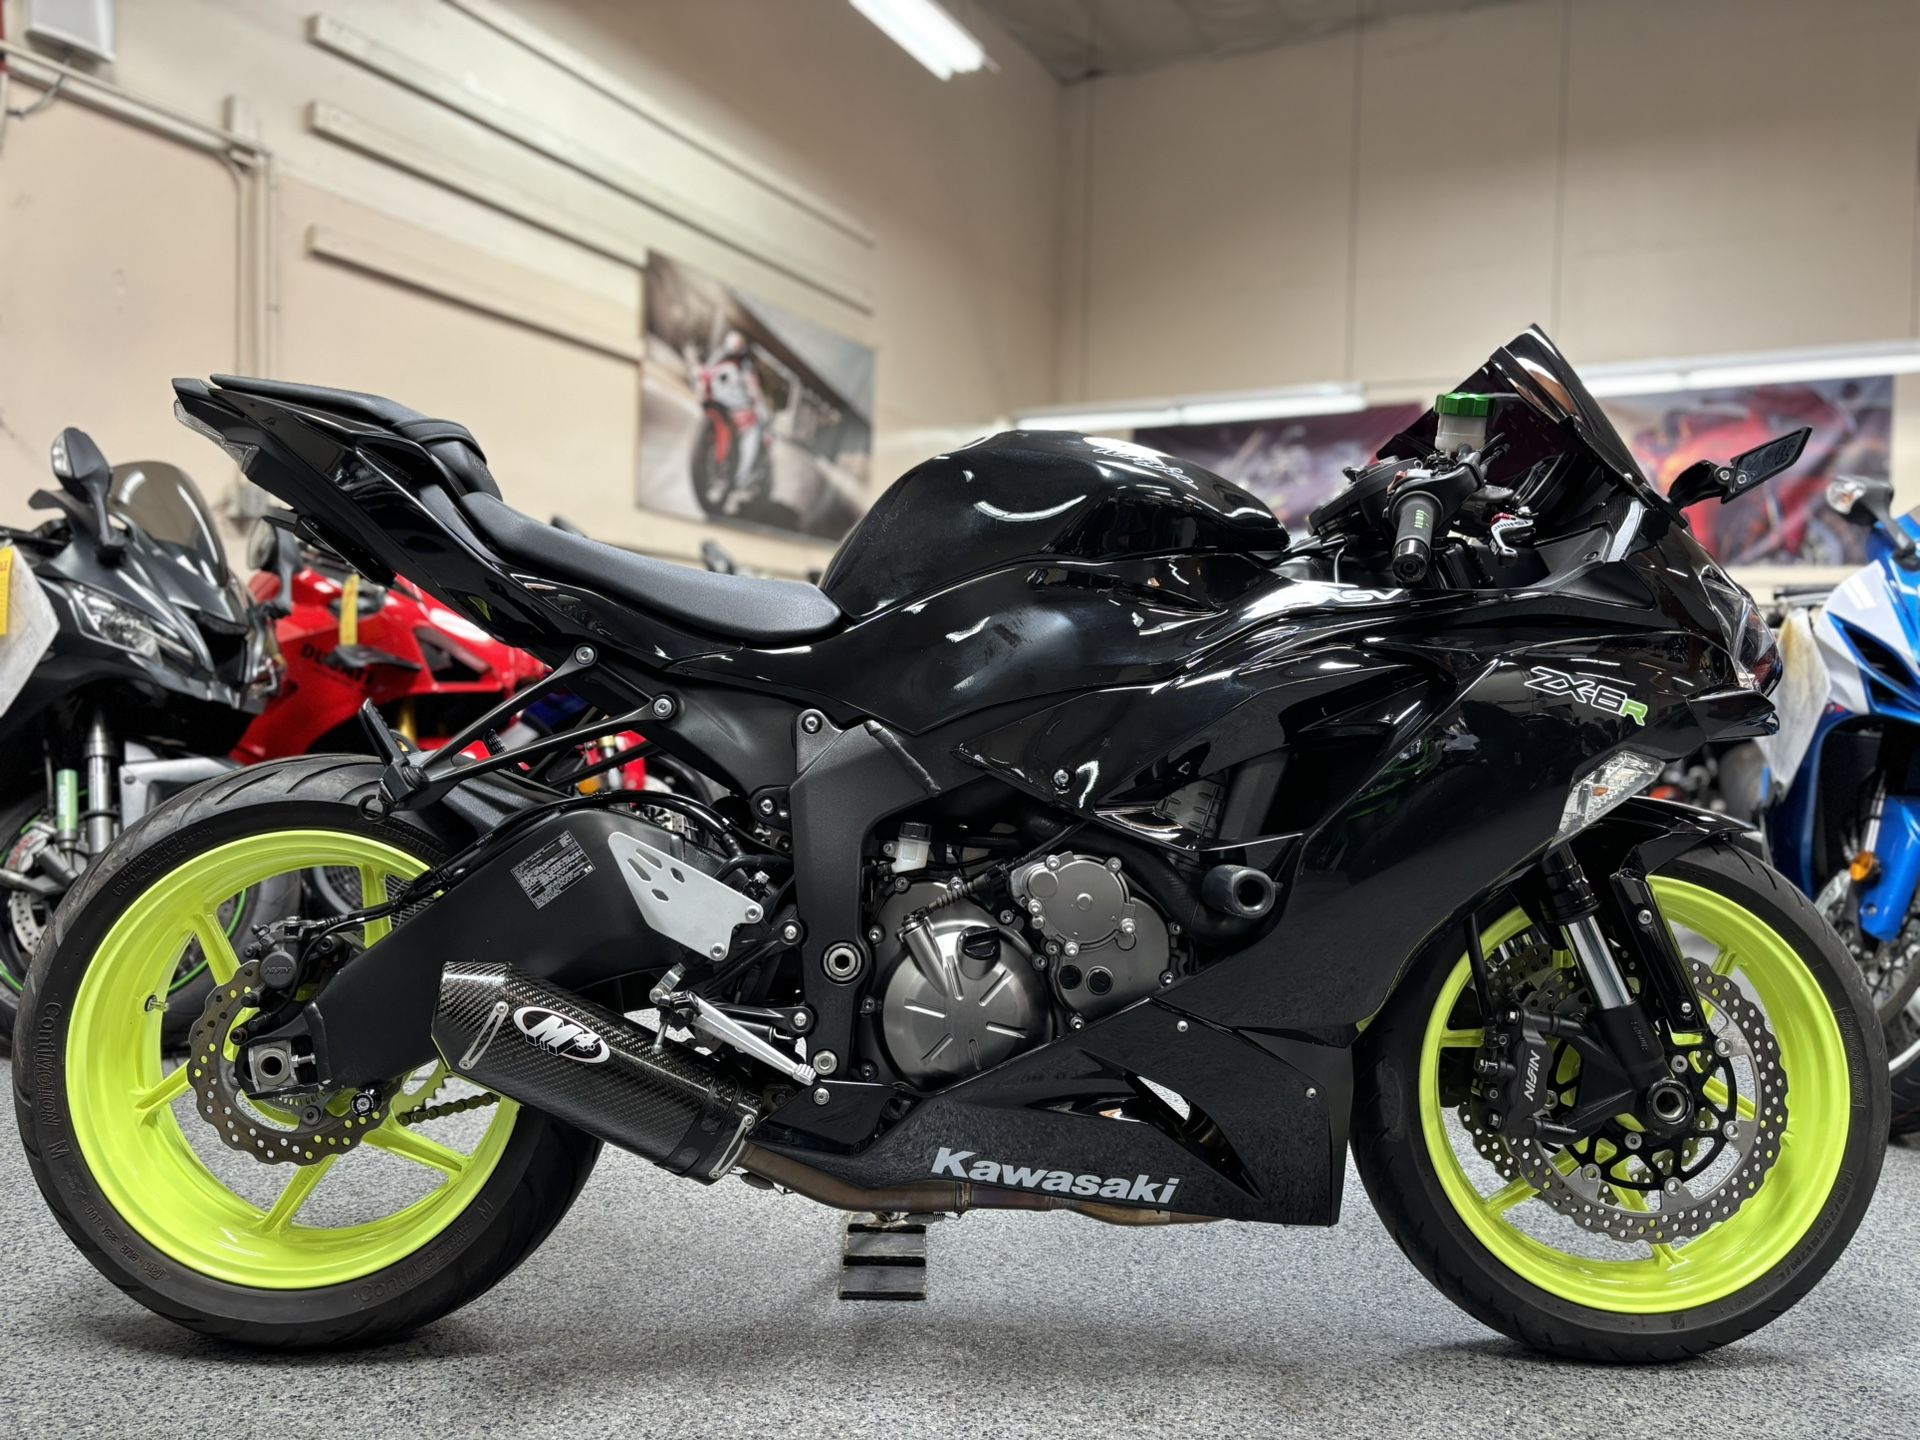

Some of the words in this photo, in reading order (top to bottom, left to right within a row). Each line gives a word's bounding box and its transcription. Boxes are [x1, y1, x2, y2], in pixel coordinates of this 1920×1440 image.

[1524, 665, 1649, 727] ZX-6R
[1523, 1049, 1541, 1101] NISSIN
[931, 1147, 1180, 1204] Kawasaki
